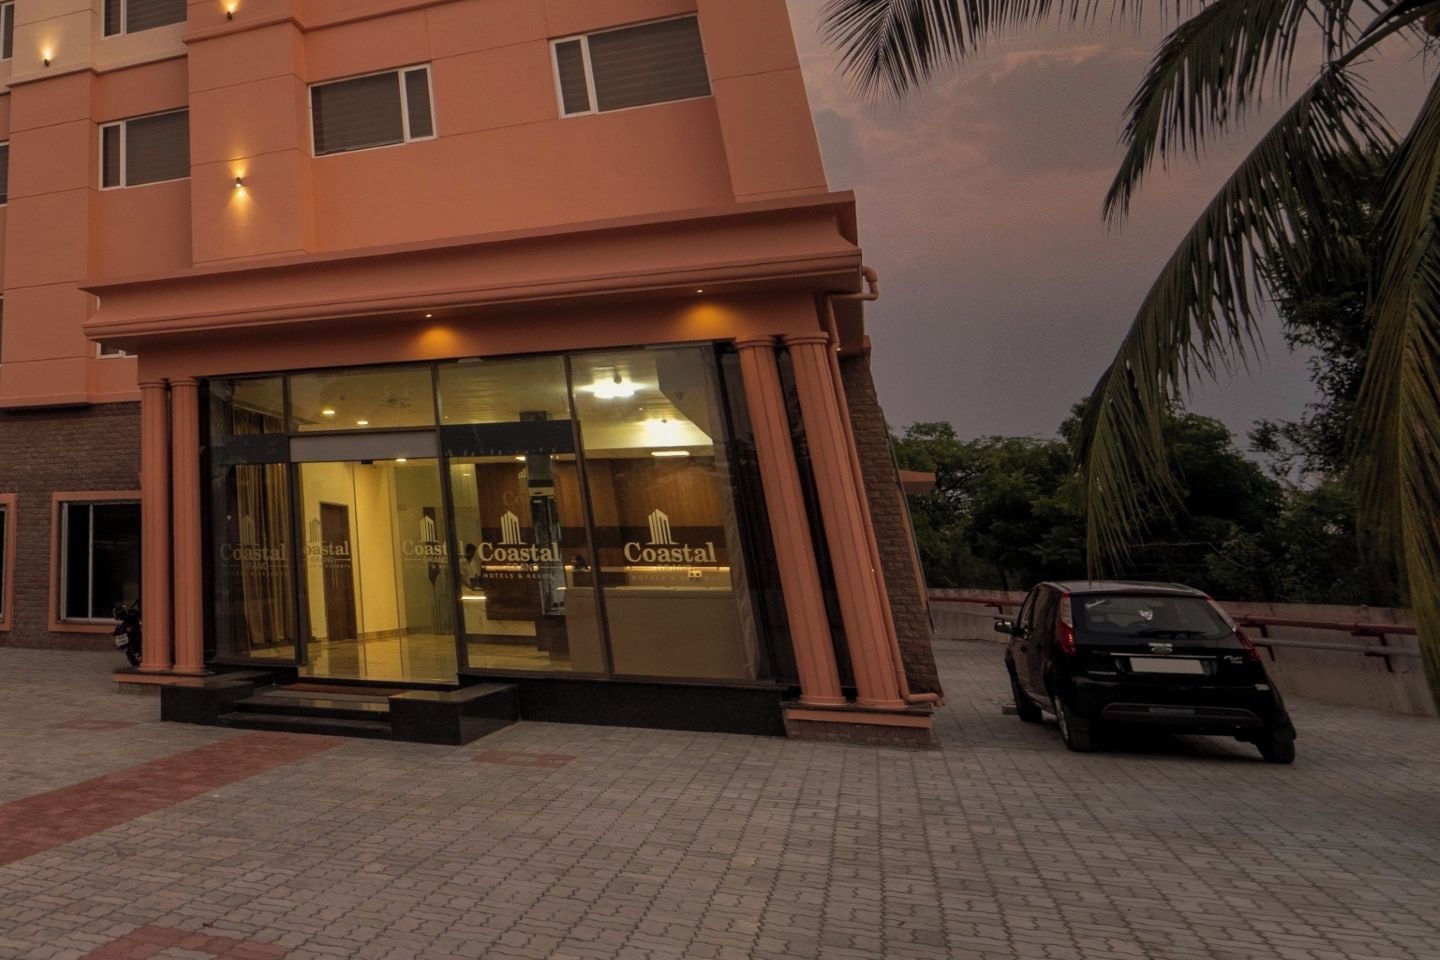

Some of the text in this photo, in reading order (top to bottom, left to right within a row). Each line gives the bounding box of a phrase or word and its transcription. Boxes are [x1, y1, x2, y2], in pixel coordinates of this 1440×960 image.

[220, 543, 288, 561] Coastal
[303, 540, 350, 556] oastal
[402, 540, 466, 556] Coastl
[478, 542, 560, 562] Coastal
[624, 542, 717, 563] Coastal
